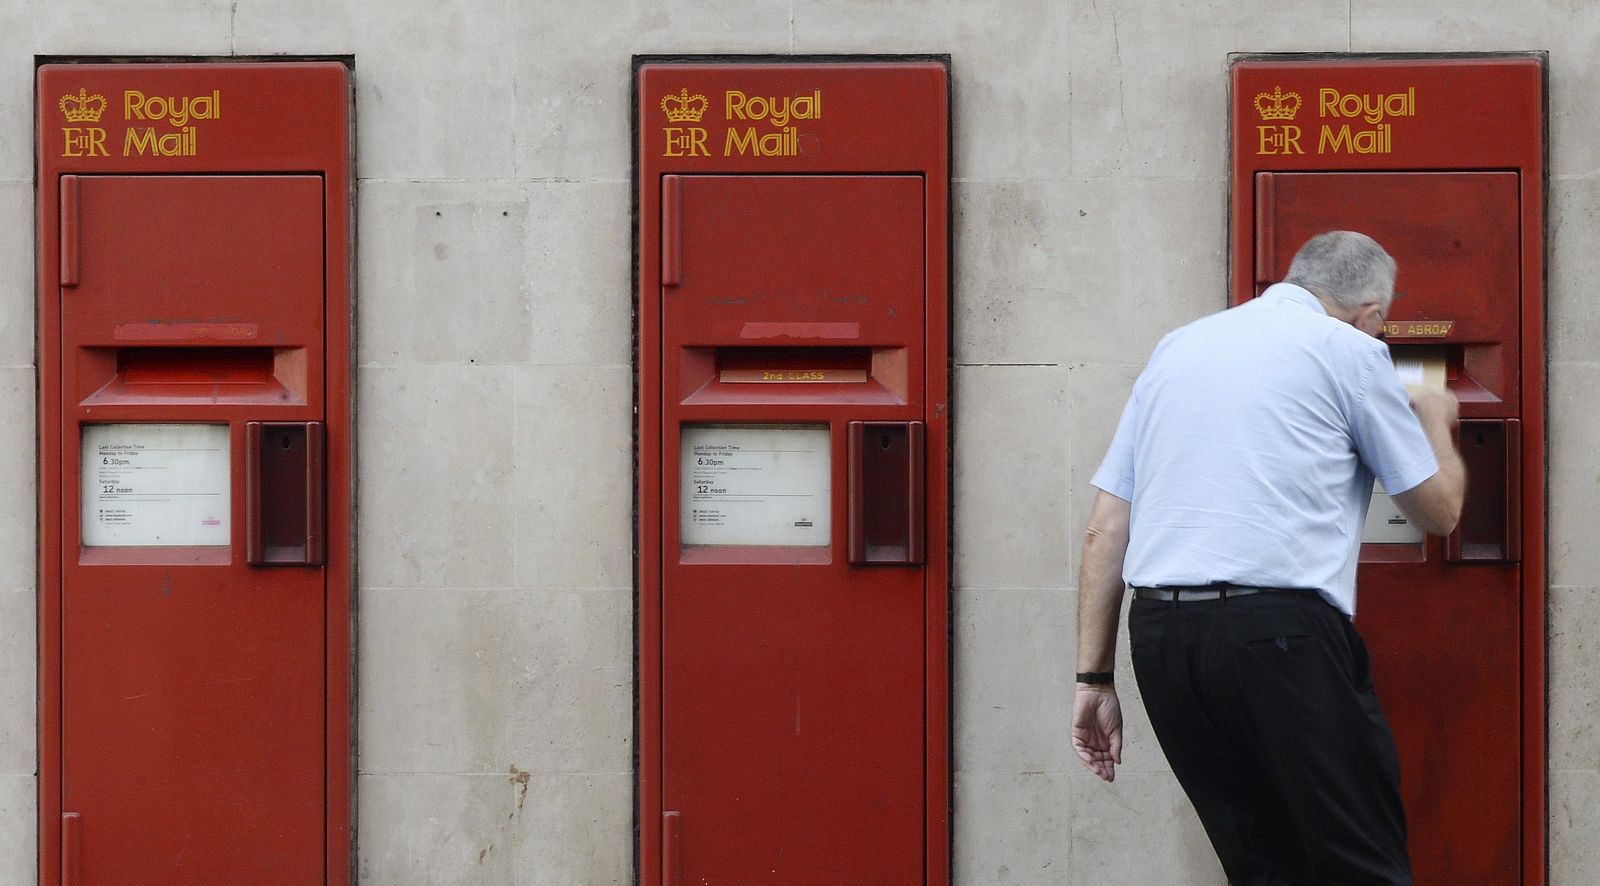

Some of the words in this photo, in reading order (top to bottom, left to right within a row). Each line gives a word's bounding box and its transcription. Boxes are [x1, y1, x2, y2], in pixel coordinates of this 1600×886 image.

[124, 90, 220, 126] Royal
[726, 90, 821, 126] Royal
[1319, 87, 1415, 124] Royal
[123, 126, 196, 157] Mail
[724, 126, 797, 157] Mail
[1318, 124, 1391, 154] Mail
[1408, 324, 1452, 335] ABROA
[763, 371, 783, 381] 2nd
[788, 371, 824, 381] CLASS
[103, 457, 129, 466] 6.30pm
[698, 457, 724, 467] 6.30pm
[103, 485, 114, 494] 12
[697, 485, 708, 494] 12
